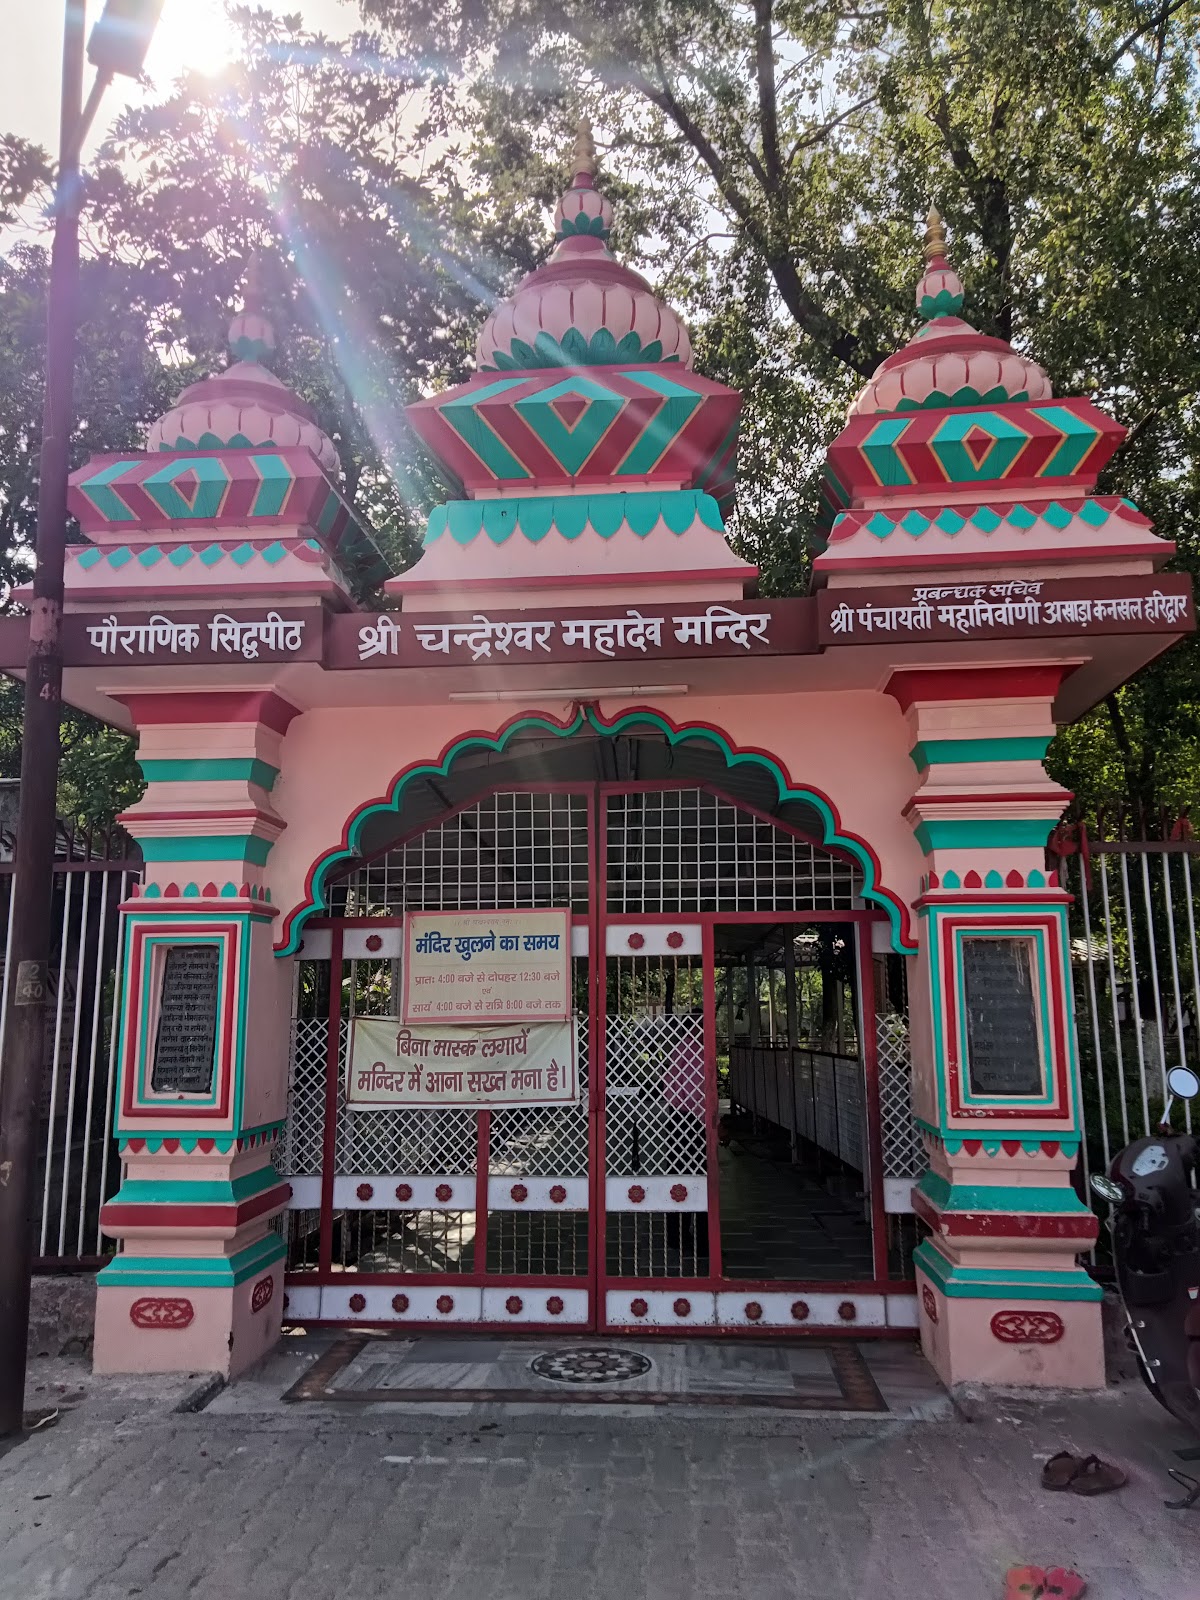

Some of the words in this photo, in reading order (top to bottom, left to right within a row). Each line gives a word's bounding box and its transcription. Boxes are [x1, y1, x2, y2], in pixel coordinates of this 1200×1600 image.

[829, 603, 856, 634] श्री
[857, 599, 935, 634] पंचायती
[937, 596, 1042, 634] महानिर्वाणी
[1042, 599, 1093, 628] अखाड़ा
[1093, 596, 1144, 622] कनखल
[1144, 590, 1188, 624] हरिद्वार
[86, 615, 200, 655] पौराणिक
[357, 614, 401, 661] श्री
[413, 614, 556, 662] चन्द्रेश्वर
[560, 610, 666, 657] महादेव
[672, 605, 772, 649] मन्दिर
[415, 930, 453, 954] मंदिर
[454, 930, 497, 961] खुलने
[499, 935, 520, 951] का
[523, 934, 560, 951] समय
[30, 964, 39, 979] 2
[415, 975, 435, 986] प्रातः
[437, 974, 455, 983] 4:00
[457, 972, 475, 983] बजे
[476, 971, 486, 983] से
[487, 971, 518, 983] दोपहर
[519, 972, 541, 982] 12:30
[543, 970, 561, 981] बजे
[412, 1000, 433, 1013] सायं
[436, 1002, 453, 1011] 4:00
[455, 1000, 472, 1011] बजे
[474, 999, 484, 1011] से
[485, 998, 503, 1010] रात्रि
[506, 999, 523, 1010] 8:00
[525, 998, 543, 1010] बजे
[544, 999, 561, 1009] तक
[395, 1029, 431, 1057] बिना
[433, 1039, 479, 1058] मास्क
[481, 1028, 531, 1058] लगायें
[357, 1061, 406, 1093] मन्दिर
[407, 1063, 424, 1093] में
[425, 1071, 464, 1093] आना
[467, 1070, 508, 1093] सख्त
[511, 1069, 543, 1090] मना
